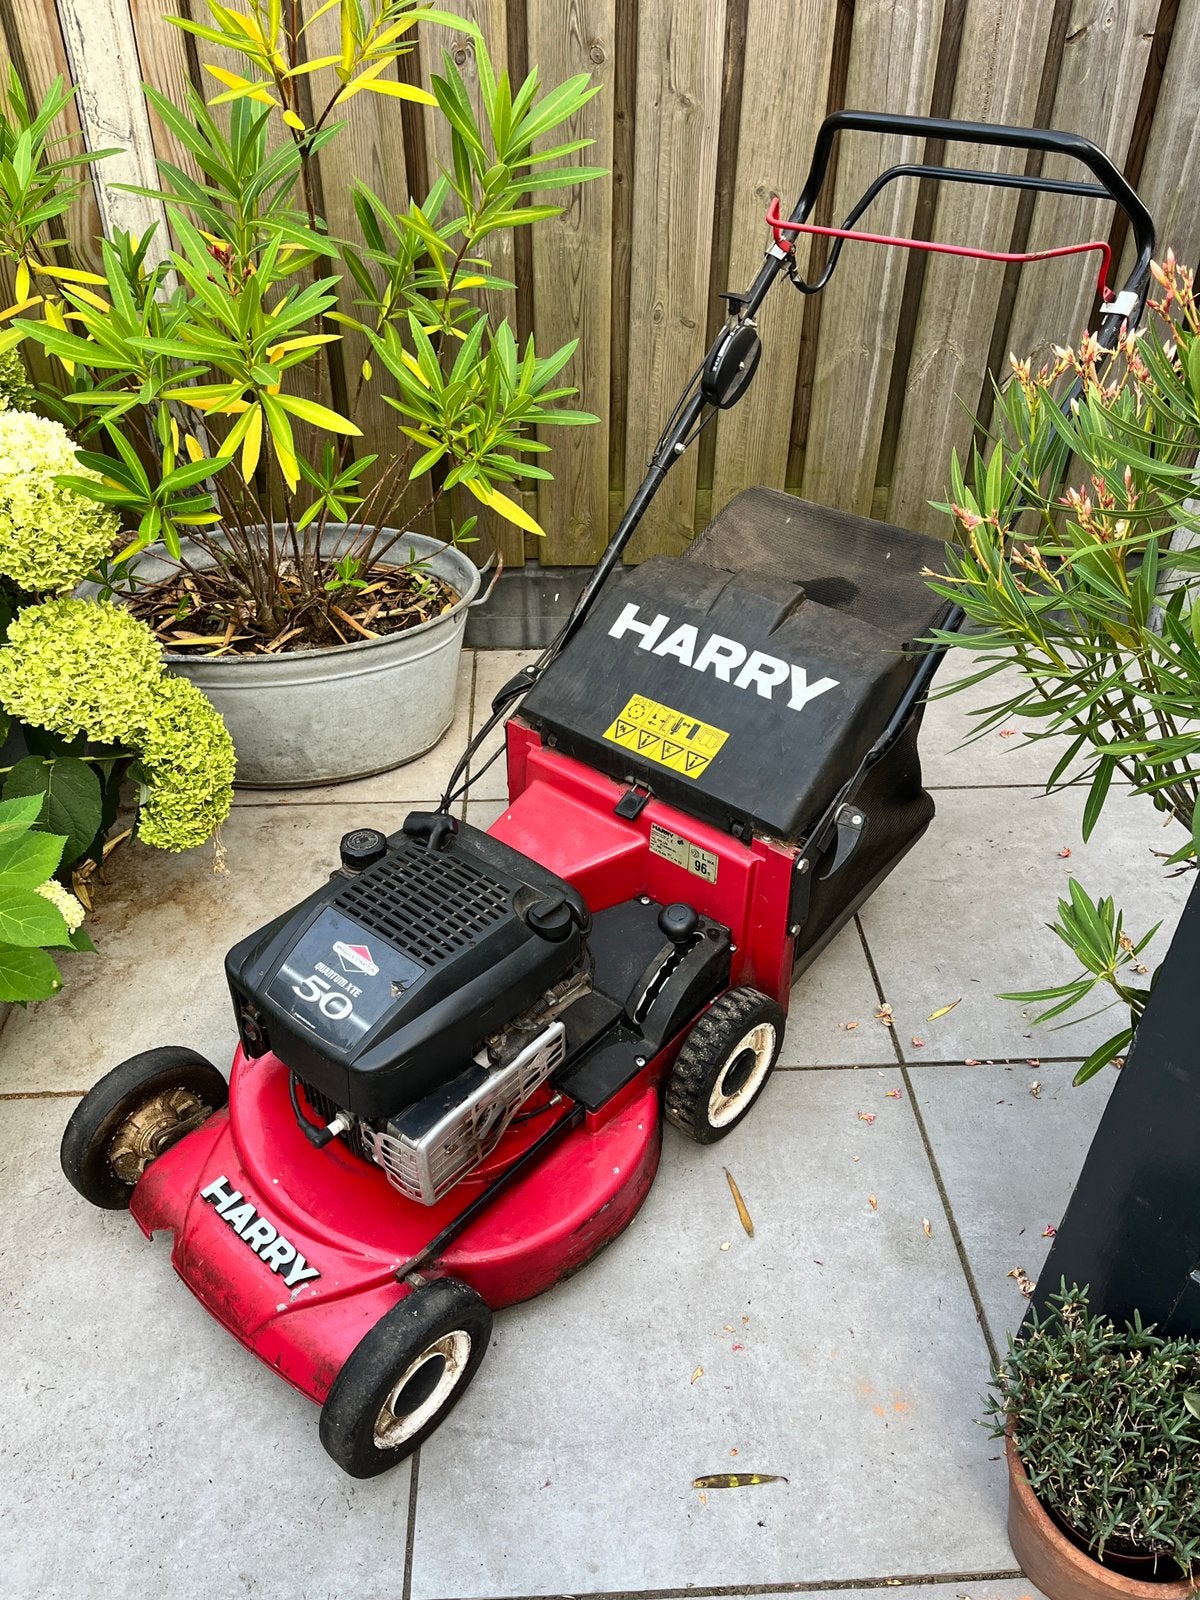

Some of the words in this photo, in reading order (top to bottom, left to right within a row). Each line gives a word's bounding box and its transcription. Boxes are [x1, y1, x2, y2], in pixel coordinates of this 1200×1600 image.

[608, 602, 841, 712] HARRY
[633, 697, 654, 708] STOP
[695, 860, 707, 874] 96
[292, 975, 353, 1020] 50
[314, 962, 349, 988] QUANTUM
[345, 981, 363, 998] XTE
[200, 1175, 320, 1287] HARRY
